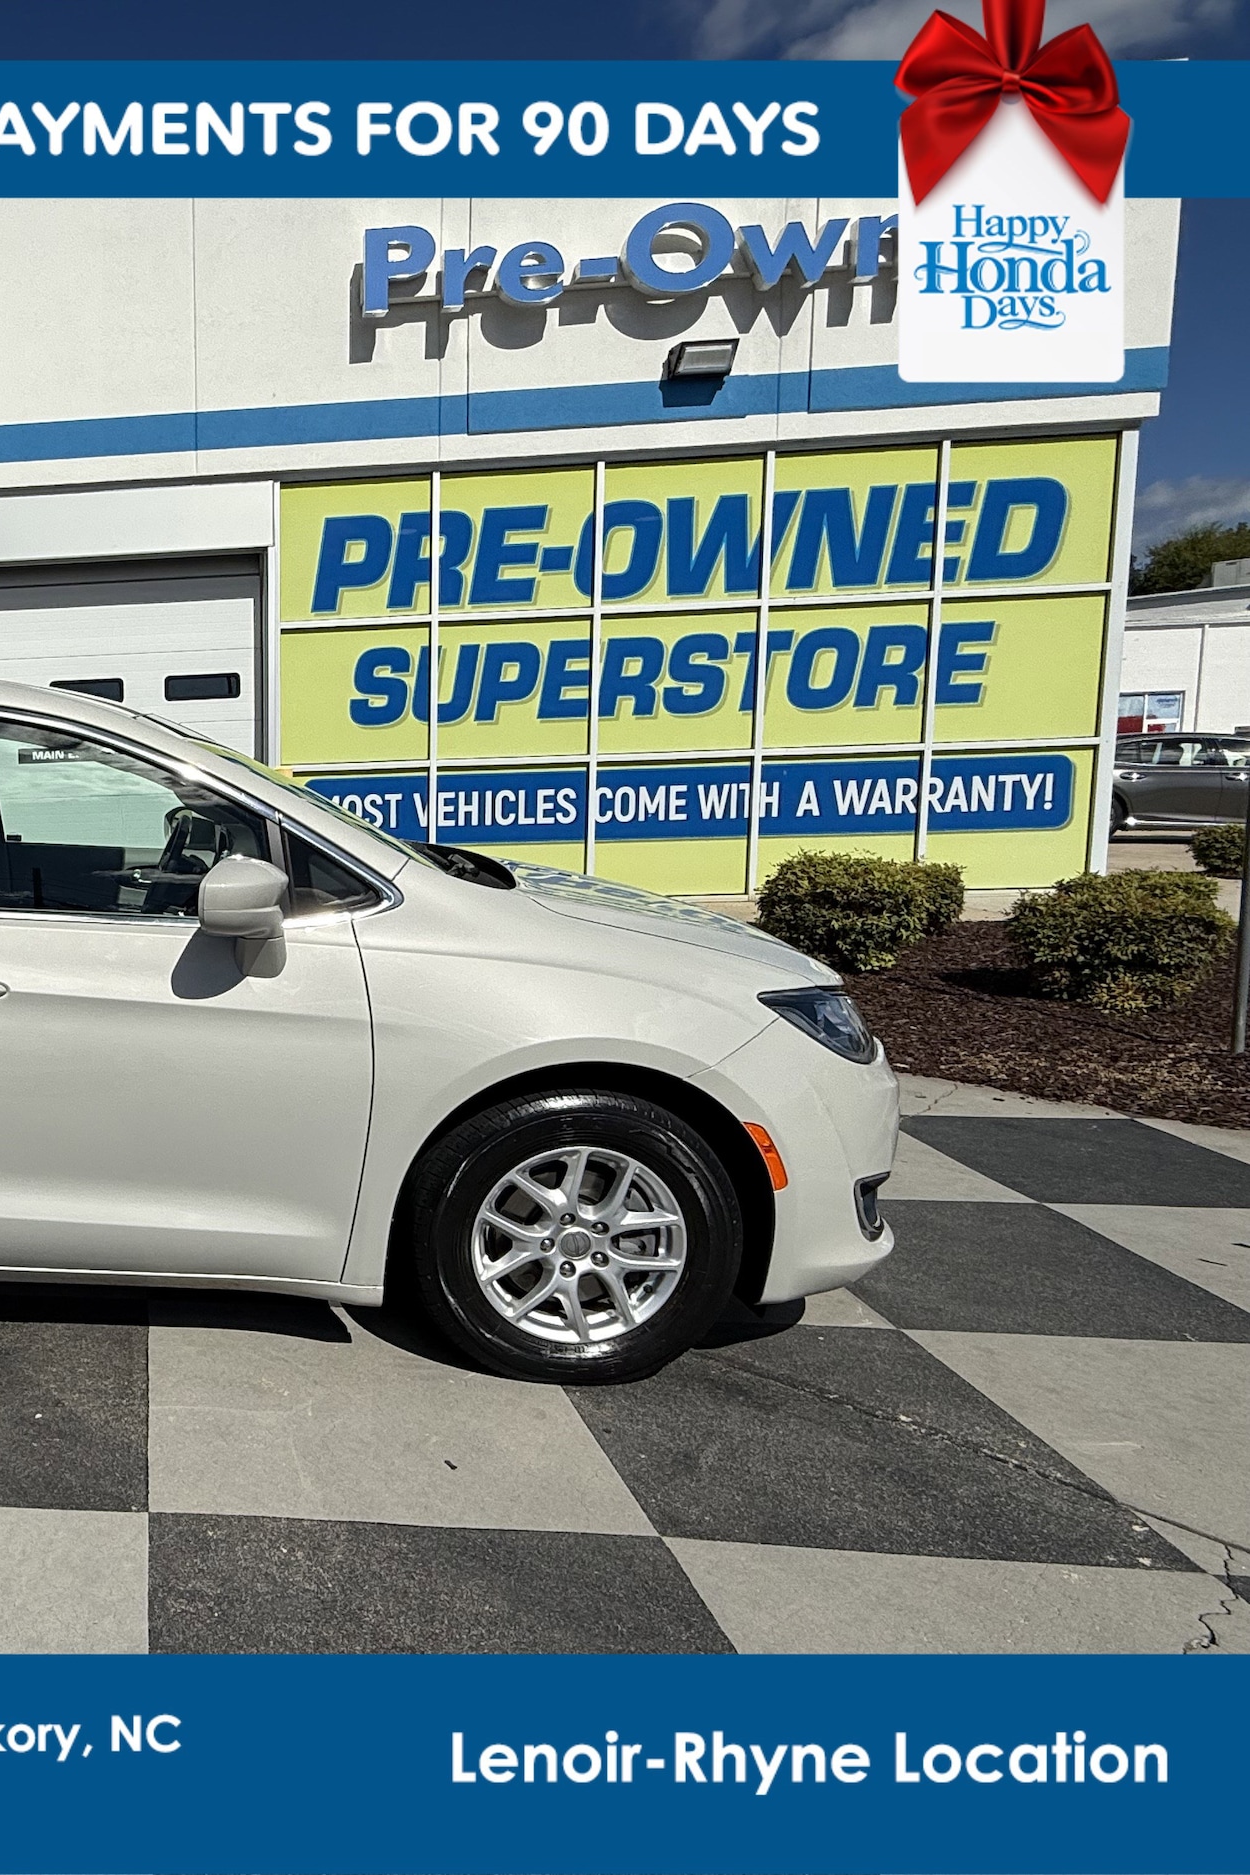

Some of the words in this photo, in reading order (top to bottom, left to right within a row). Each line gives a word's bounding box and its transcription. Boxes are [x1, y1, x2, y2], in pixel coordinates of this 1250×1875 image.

[310, 477, 1069, 613] PRE-OWNED
[348, 621, 997, 727] SUPERSTORE
[32, 750, 65, 760] MAIN
[331, 792, 403, 829] OST
[413, 787, 577, 828] VEHICLES
[594, 785, 687, 823] COME
[697, 781, 780, 820] WITH
[796, 780, 820, 816] A
[833, 773, 1055, 816] WARRANTY!
